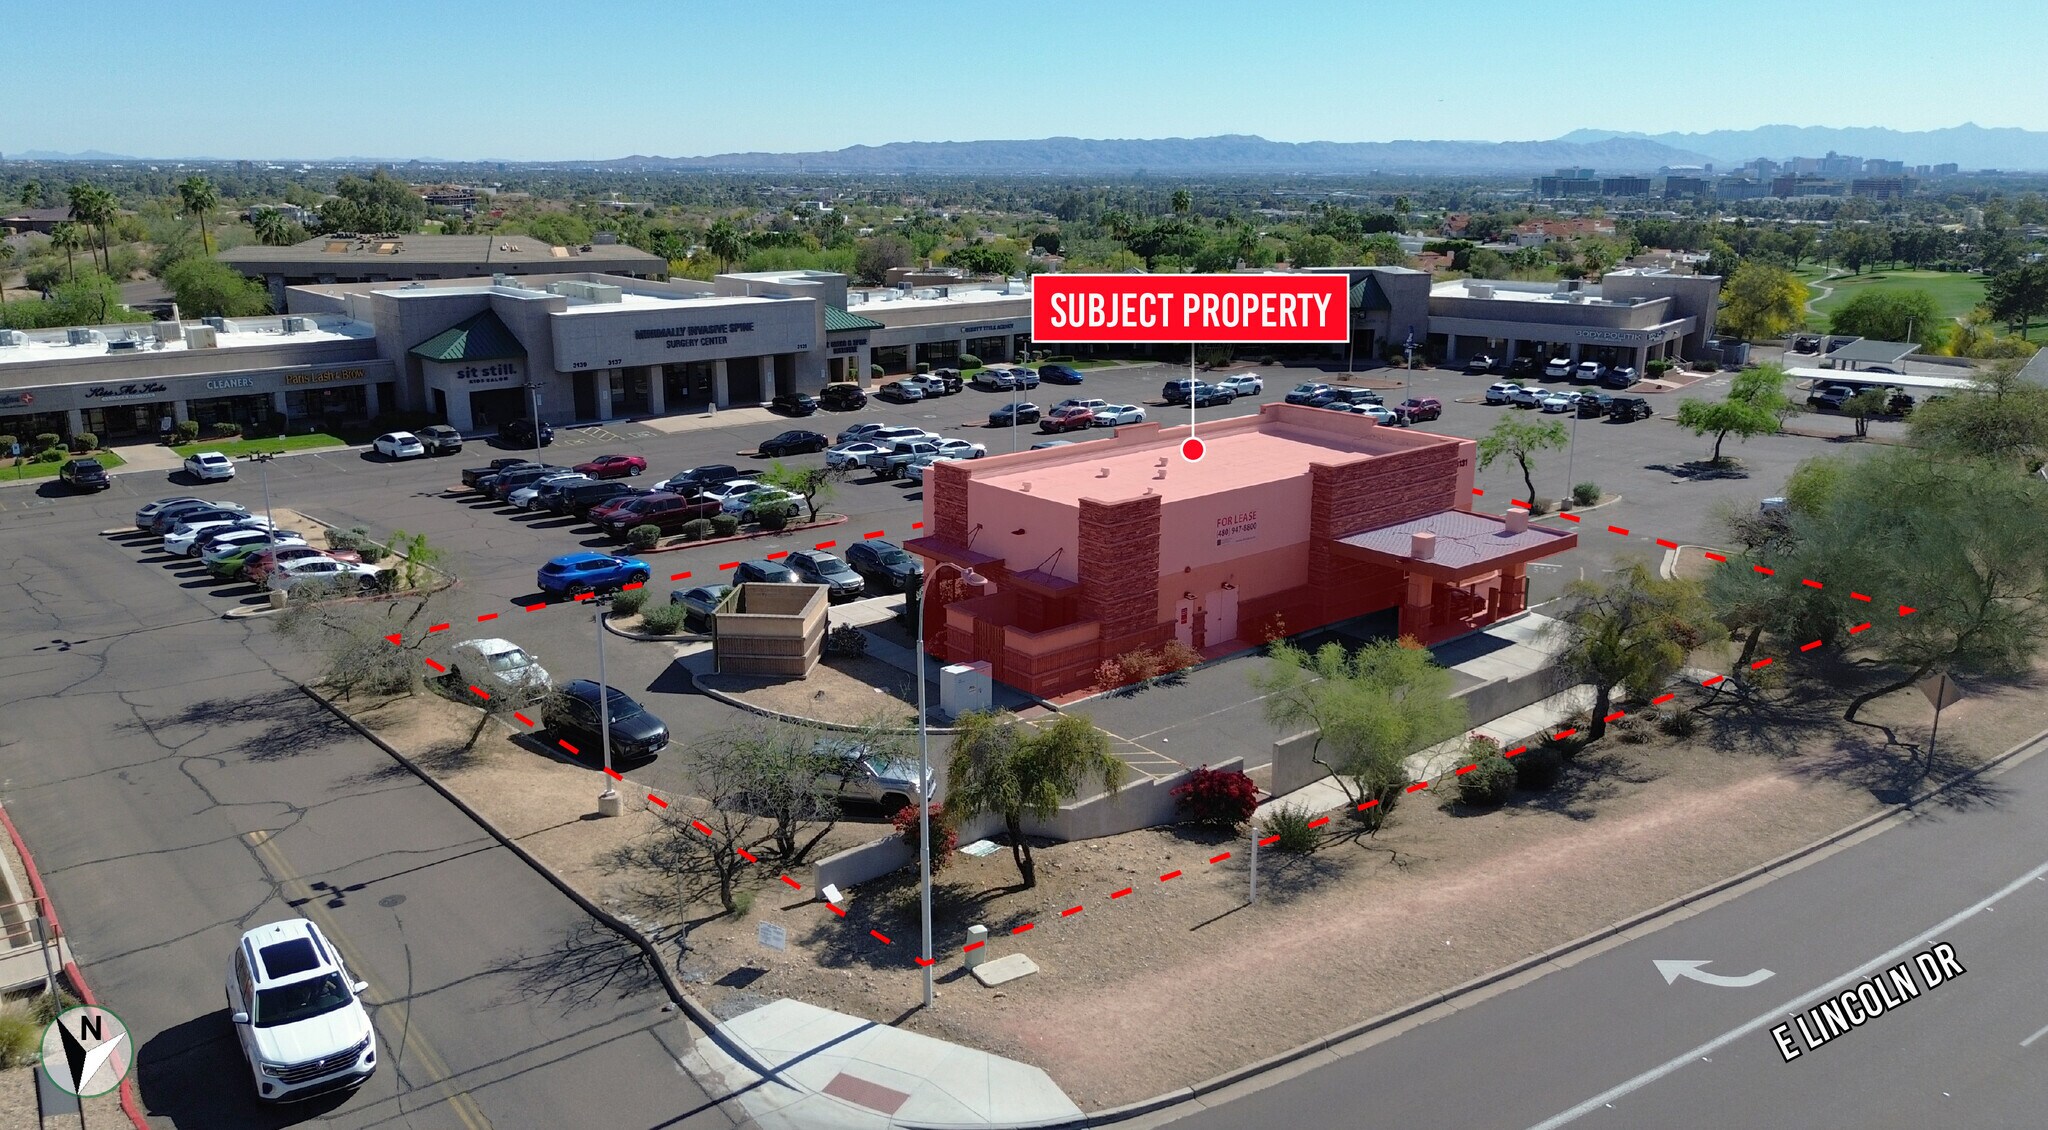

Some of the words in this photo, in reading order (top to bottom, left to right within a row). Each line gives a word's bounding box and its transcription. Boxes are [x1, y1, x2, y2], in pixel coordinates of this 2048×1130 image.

[634, 326, 686, 340] MINIMALLY
[687, 324, 728, 336] INVASIVE
[729, 322, 754, 333] SPINE
[1576, 330, 1602, 338] BODY
[1603, 332, 1641, 341] POLITIK
[666, 338, 698, 349] SURGERY
[700, 335, 727, 346] CENTER
[286, 373, 310, 385] Paris
[311, 370, 334, 383] Lash
[342, 369, 364, 380] Brow
[456, 366, 479, 379] sit
[206, 377, 254, 390] CLEANERS
[1217, 516, 1232, 527] FOR
[1234, 511, 1256, 523] LEASE
